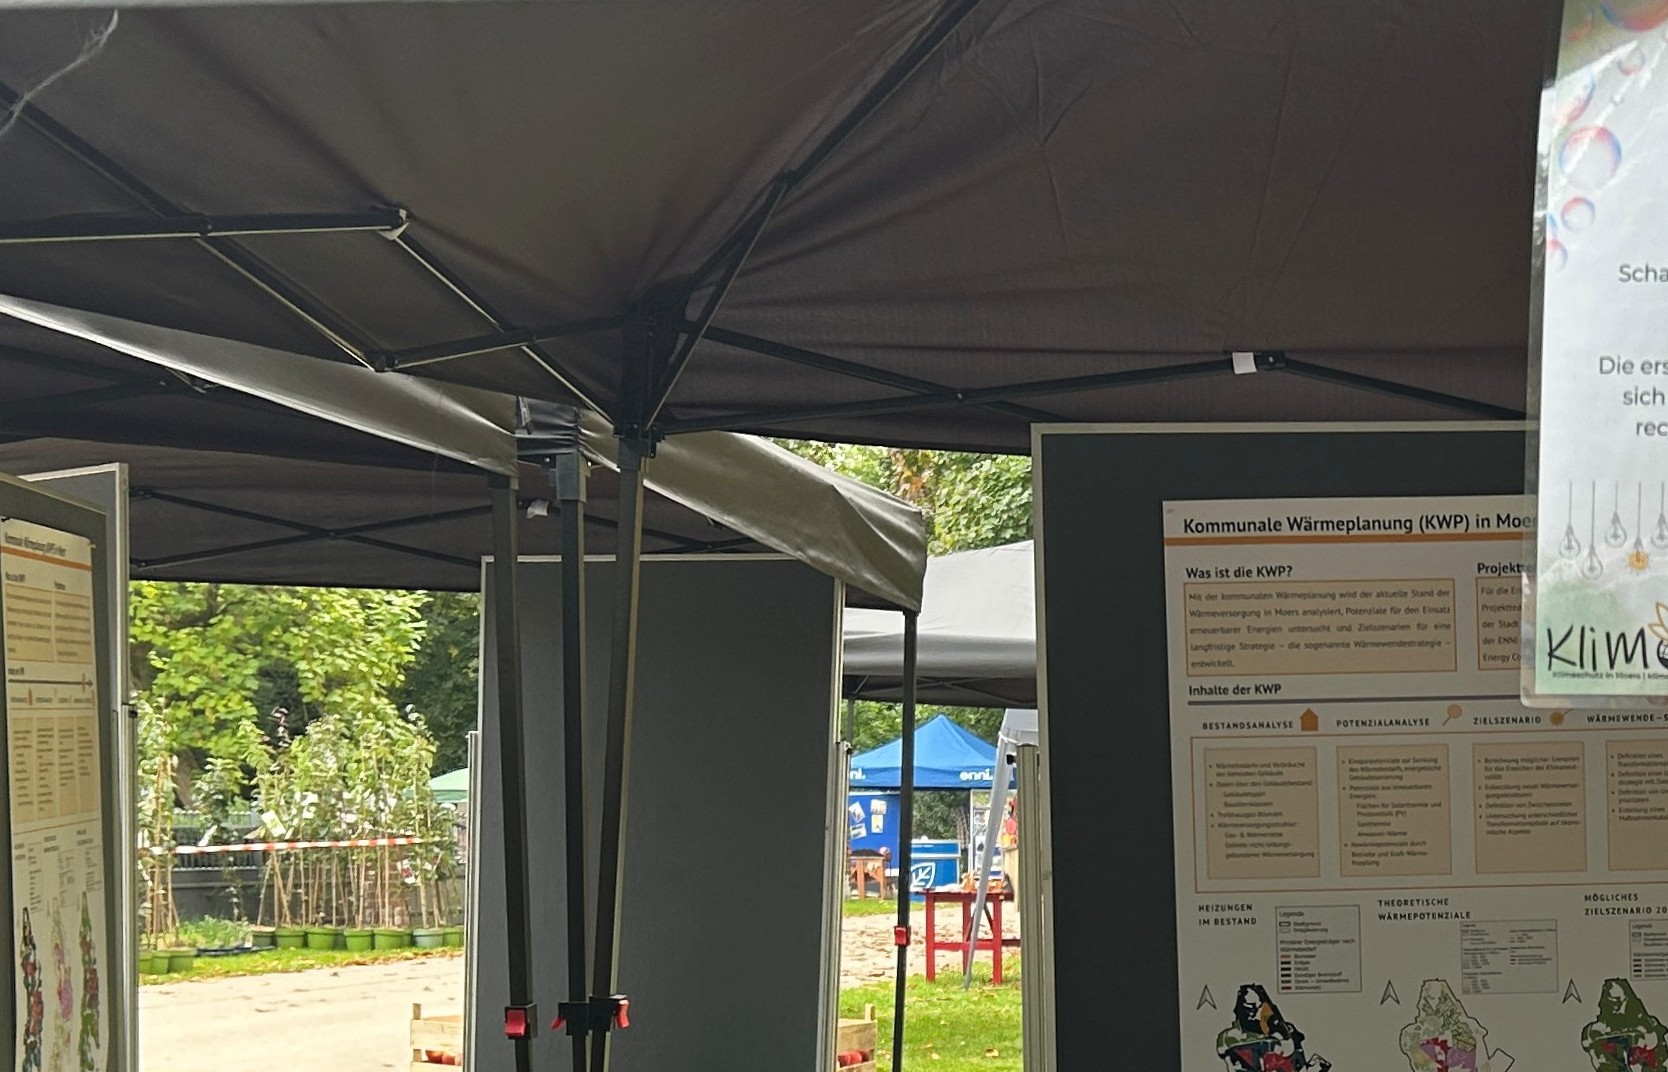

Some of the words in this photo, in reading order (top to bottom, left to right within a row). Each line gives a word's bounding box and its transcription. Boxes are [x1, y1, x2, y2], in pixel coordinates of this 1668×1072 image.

[1599, 357, 1635, 376] Die
[1622, 387, 1665, 408] sich
[1183, 516, 1283, 534] Kommunale
[1286, 513, 1414, 536] Wärmeplanung
[1418, 512, 1471, 534] (KWP)
[1475, 513, 1491, 530] in
[1496, 512, 1537, 530] Moer
[1186, 566, 1212, 579] Was
[1214, 565, 1230, 578] ist
[1232, 565, 1253, 578] die
[1255, 564, 1293, 578] KWP?
[1188, 684, 1230, 697] Inhalte
[1232, 684, 1251, 696] der
[1254, 683, 1282, 695] KWP
[1202, 720, 1294, 731] BESTANDSANALYSE
[1336, 717, 1430, 729] POTENZIALANALYSE
[1473, 715, 1542, 726] ZIELSZENARIO
[1584, 891, 1639, 903] MÖGLICHES
[1198, 903, 1253, 914] HEIZUNGEN
[1378, 898, 1450, 908] THEORETISCHE
[1378, 910, 1472, 921] WÄRMEPOTENZIALE
[1584, 906, 1653, 917] ZIELSZENARIO
[1199, 917, 1211, 927] IM
[1214, 916, 1257, 927] BESTAND
